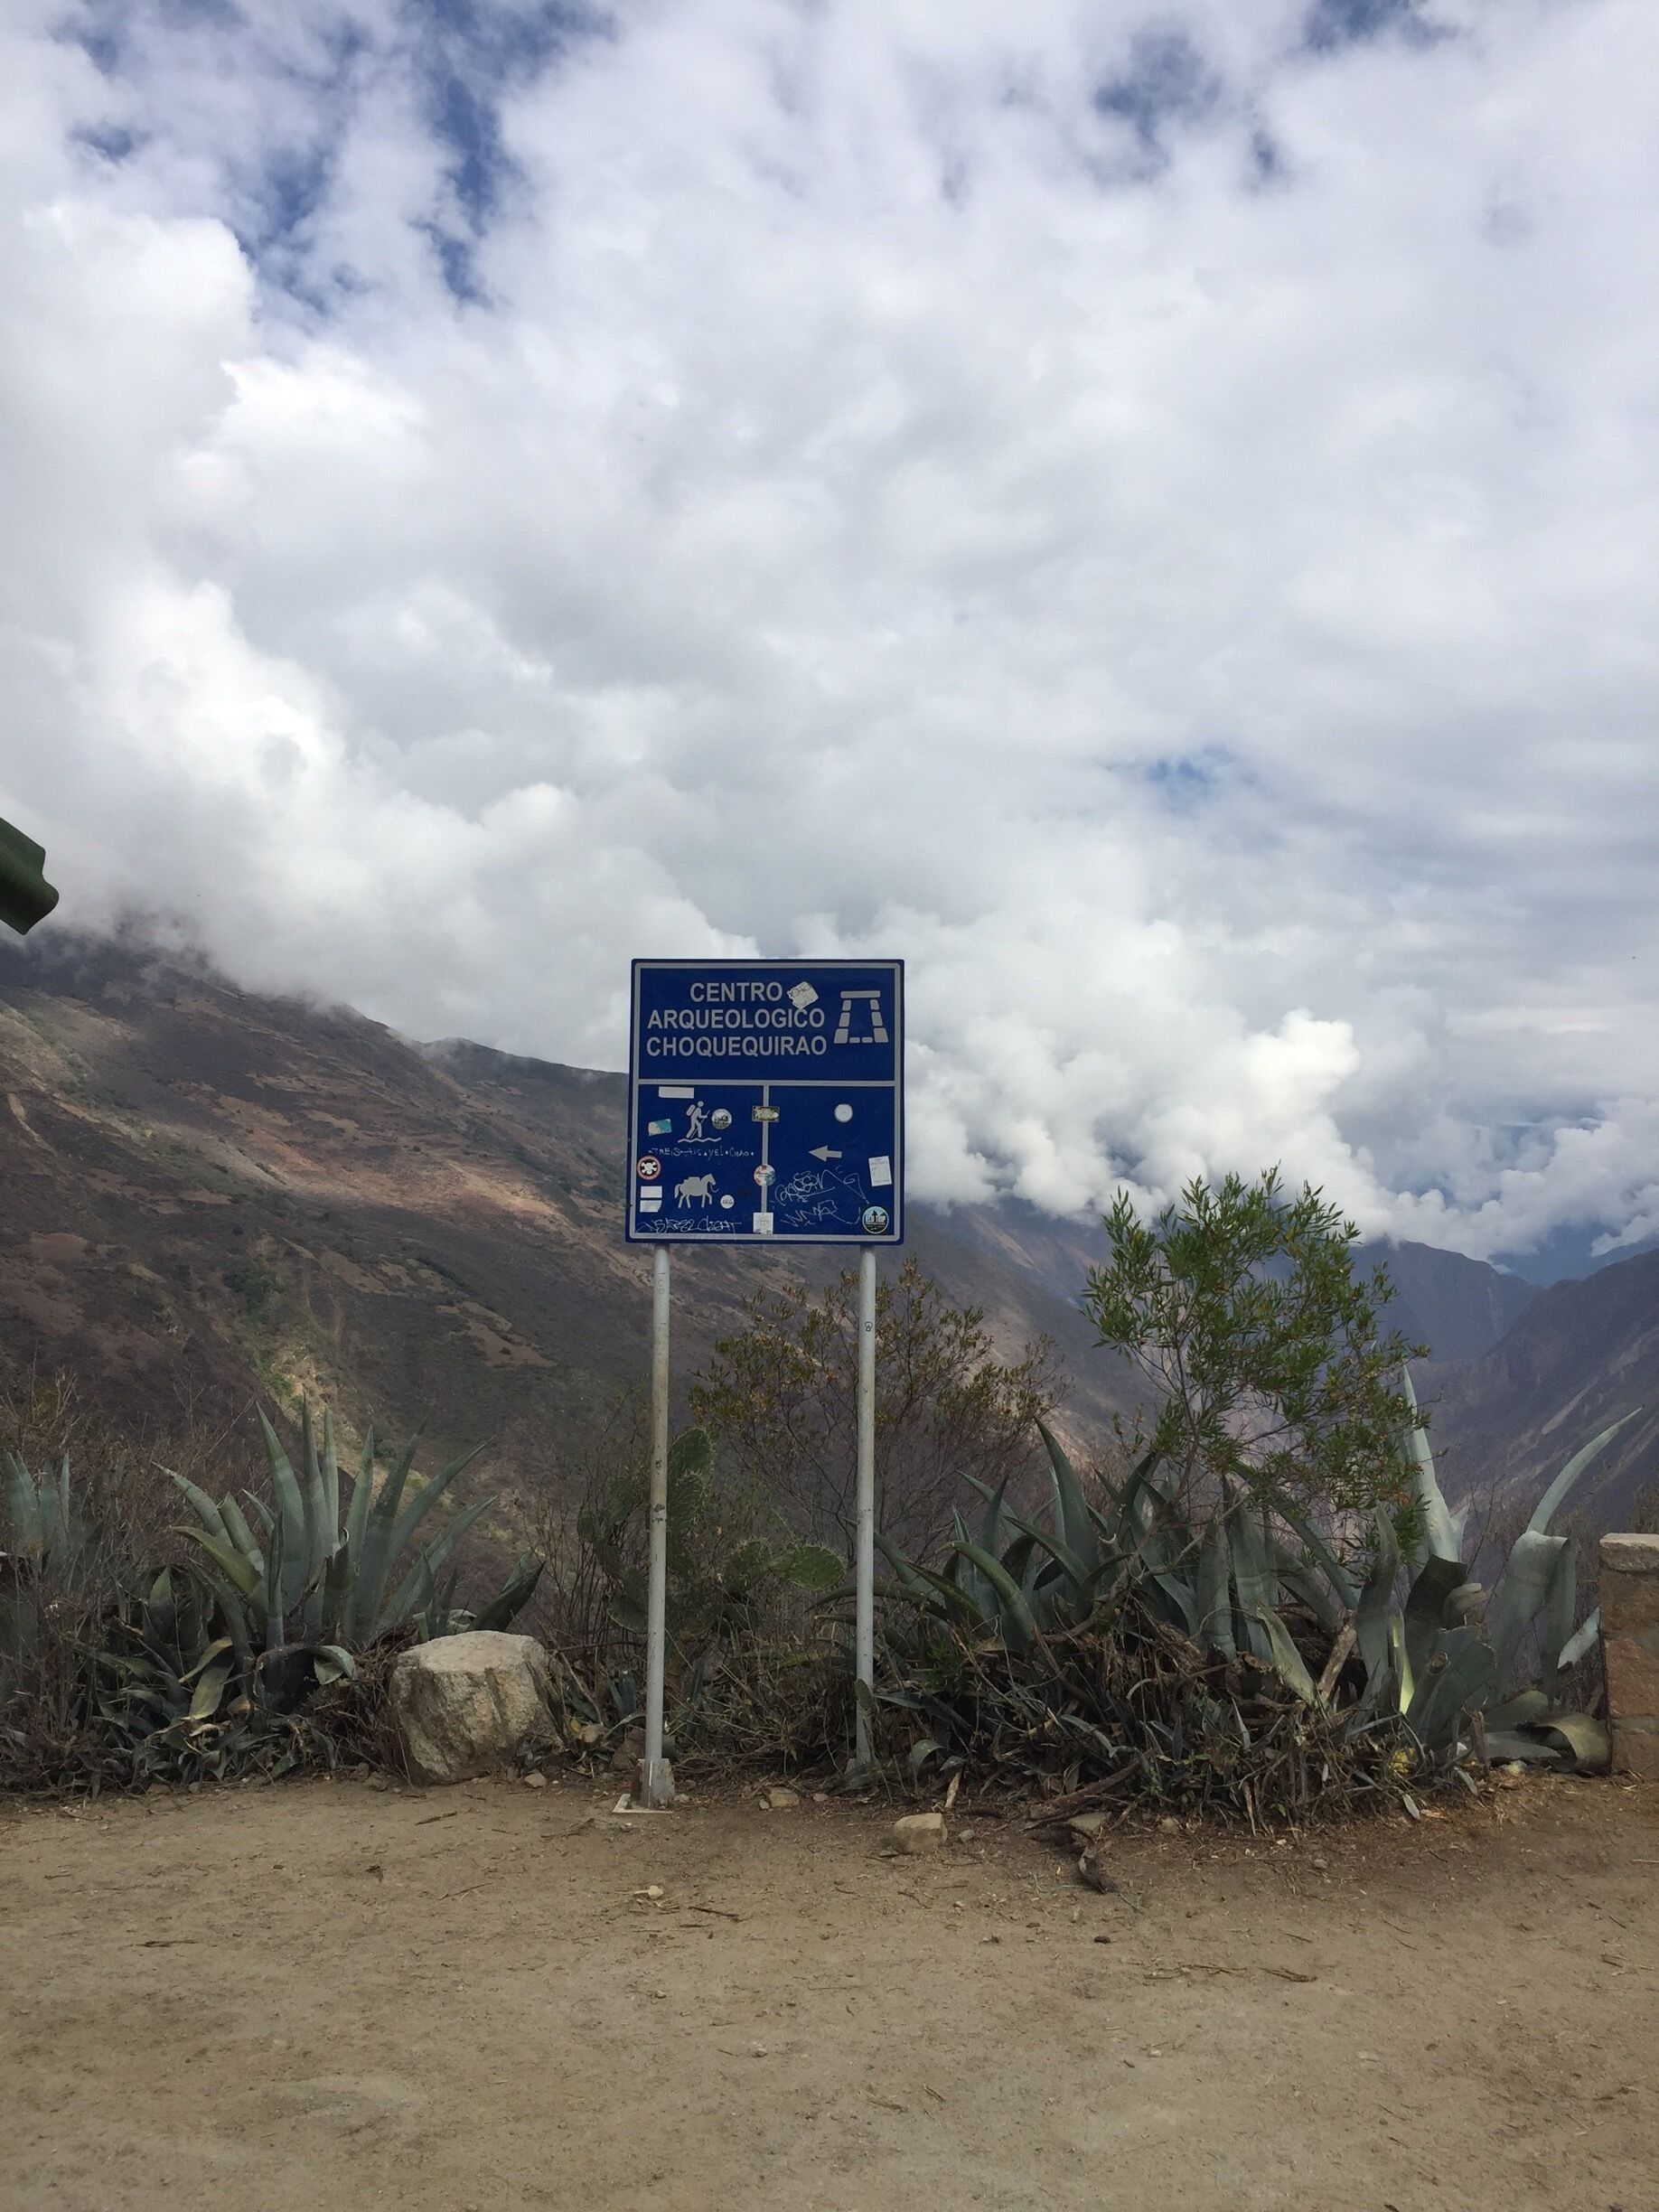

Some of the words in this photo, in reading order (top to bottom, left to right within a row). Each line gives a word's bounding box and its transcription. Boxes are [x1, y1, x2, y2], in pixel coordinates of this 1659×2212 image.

[689, 982, 783, 1002] CENTRO
[647, 1008, 825, 1030] ARQUEOLOGICO
[646, 1036, 827, 1057] CHOQUEQUIRAO
